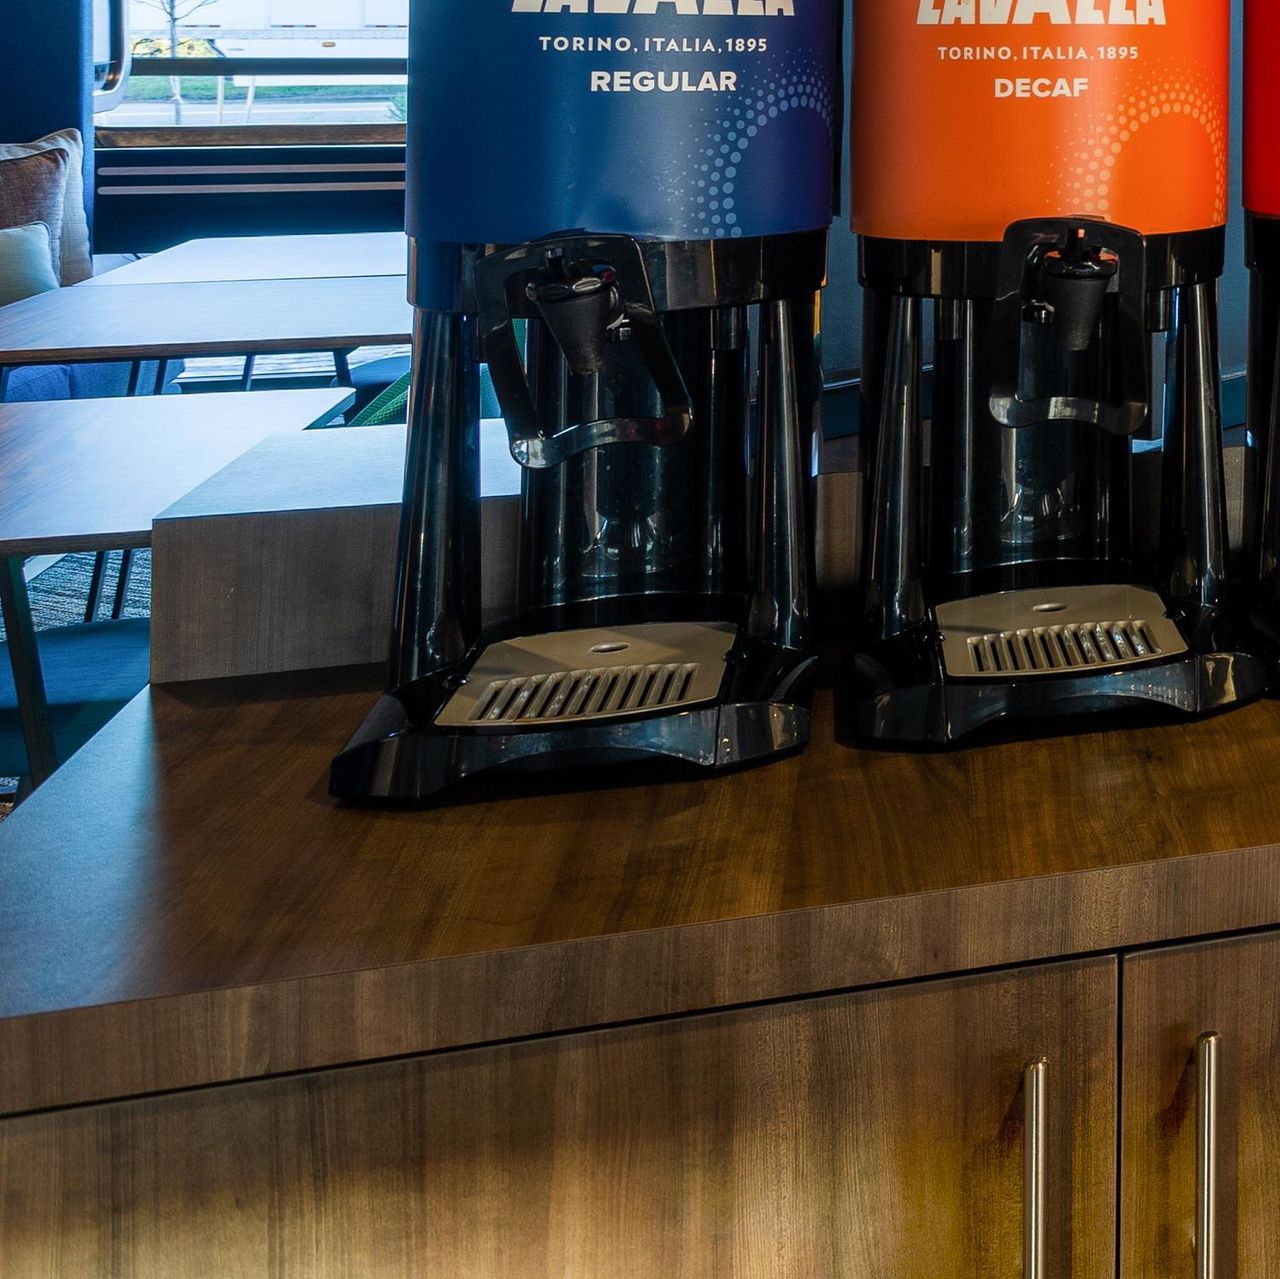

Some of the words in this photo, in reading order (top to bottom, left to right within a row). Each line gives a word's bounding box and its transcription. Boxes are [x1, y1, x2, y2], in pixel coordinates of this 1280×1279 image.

[539, 36, 639, 54] TORINO,
[644, 36, 723, 54] ITALIA,
[725, 36, 768, 53] 1895
[938, 46, 1017, 62] TORINO,
[1022, 46, 1095, 62] ITALIA,
[1097, 46, 1139, 60] 1895
[590, 71, 737, 93] REGULAR
[994, 77, 1089, 98] DECAF
